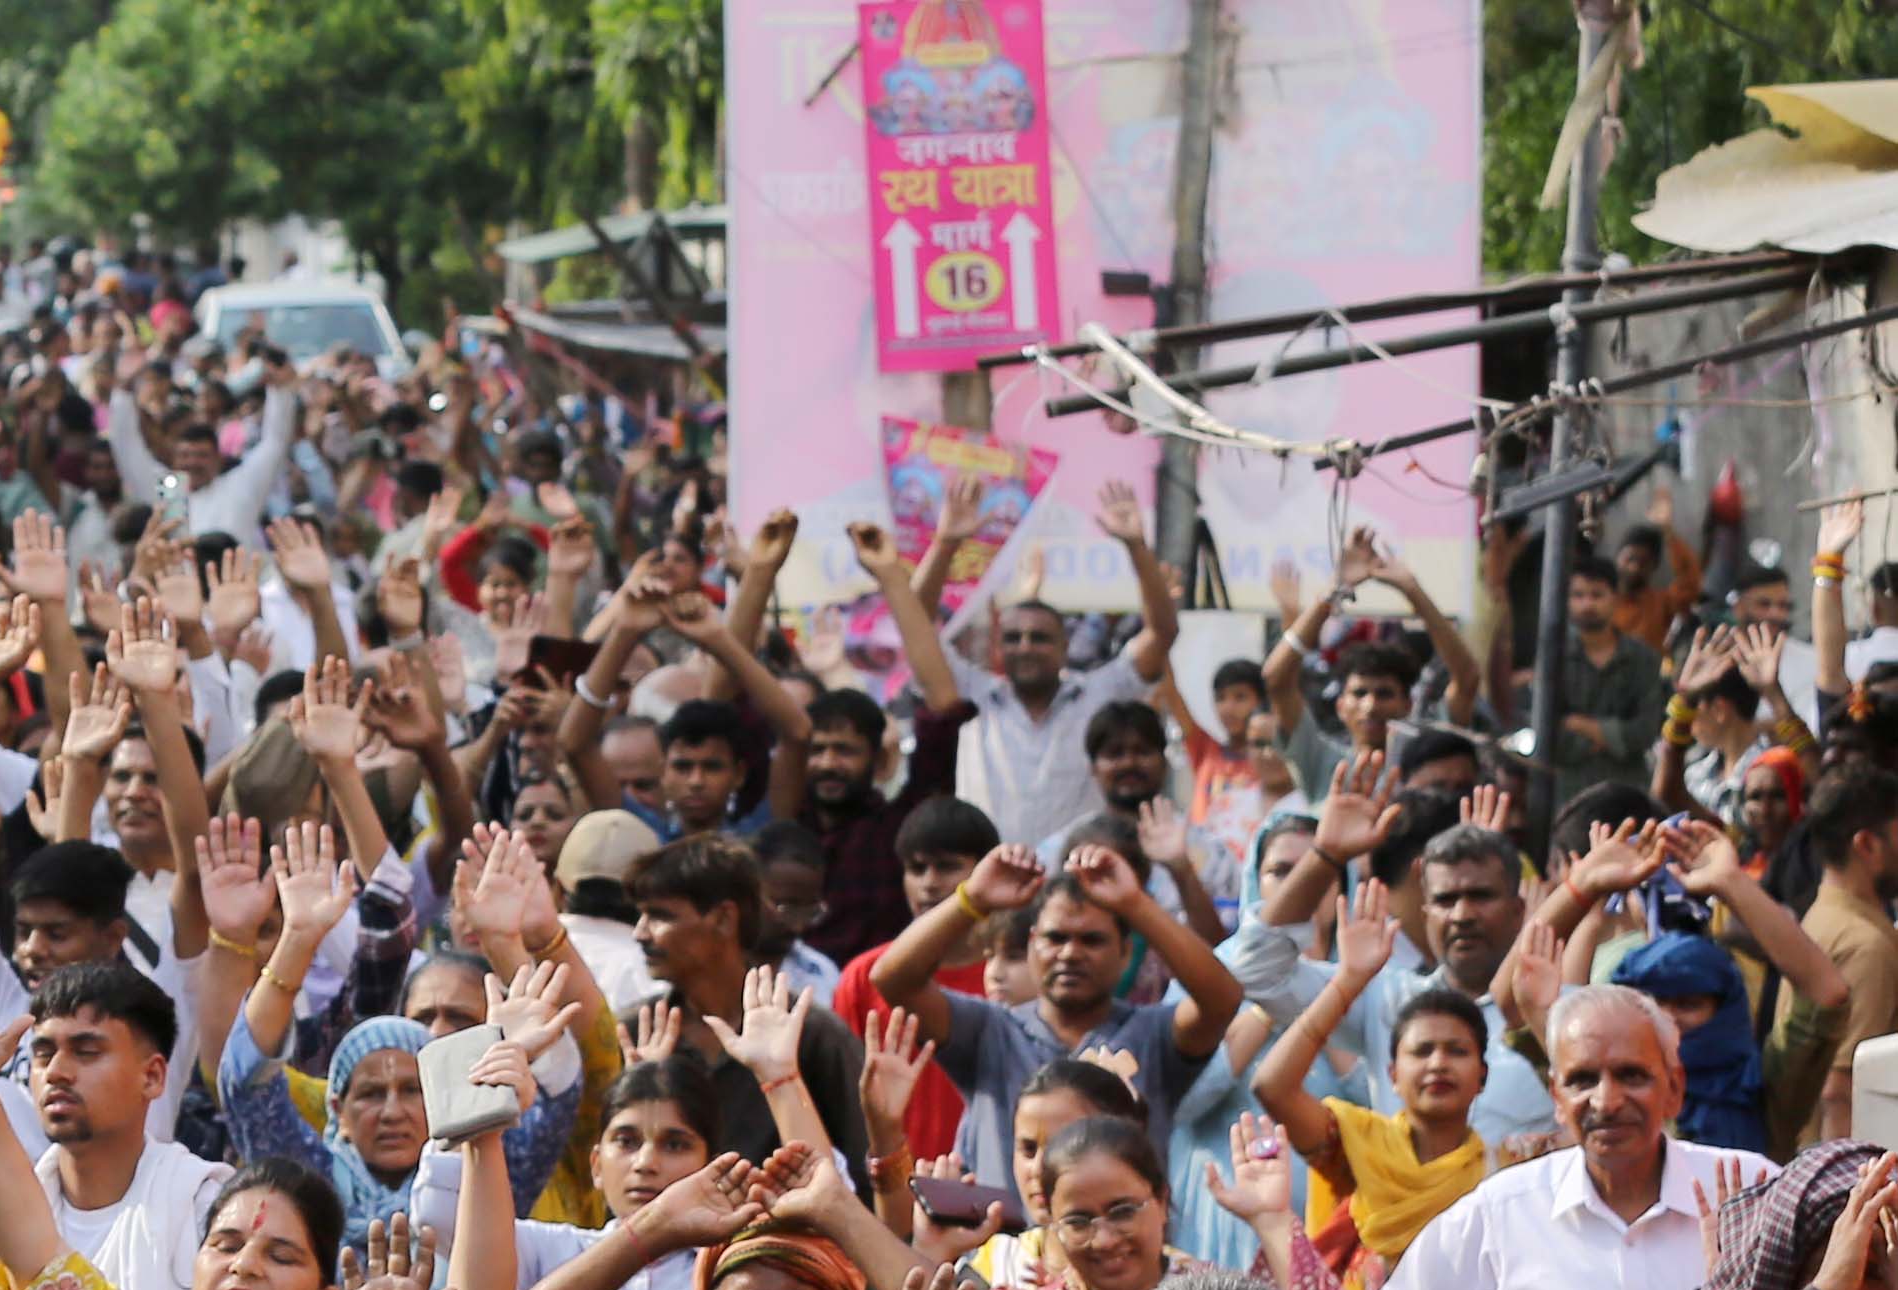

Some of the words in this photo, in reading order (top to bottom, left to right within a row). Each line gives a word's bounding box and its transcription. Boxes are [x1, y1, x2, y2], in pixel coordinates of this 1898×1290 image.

[878, 168, 940, 213] रथ
[950, 164, 1039, 208] यात्रा
[929, 210, 992, 251] मार्ग
[941, 262, 988, 300] 16
